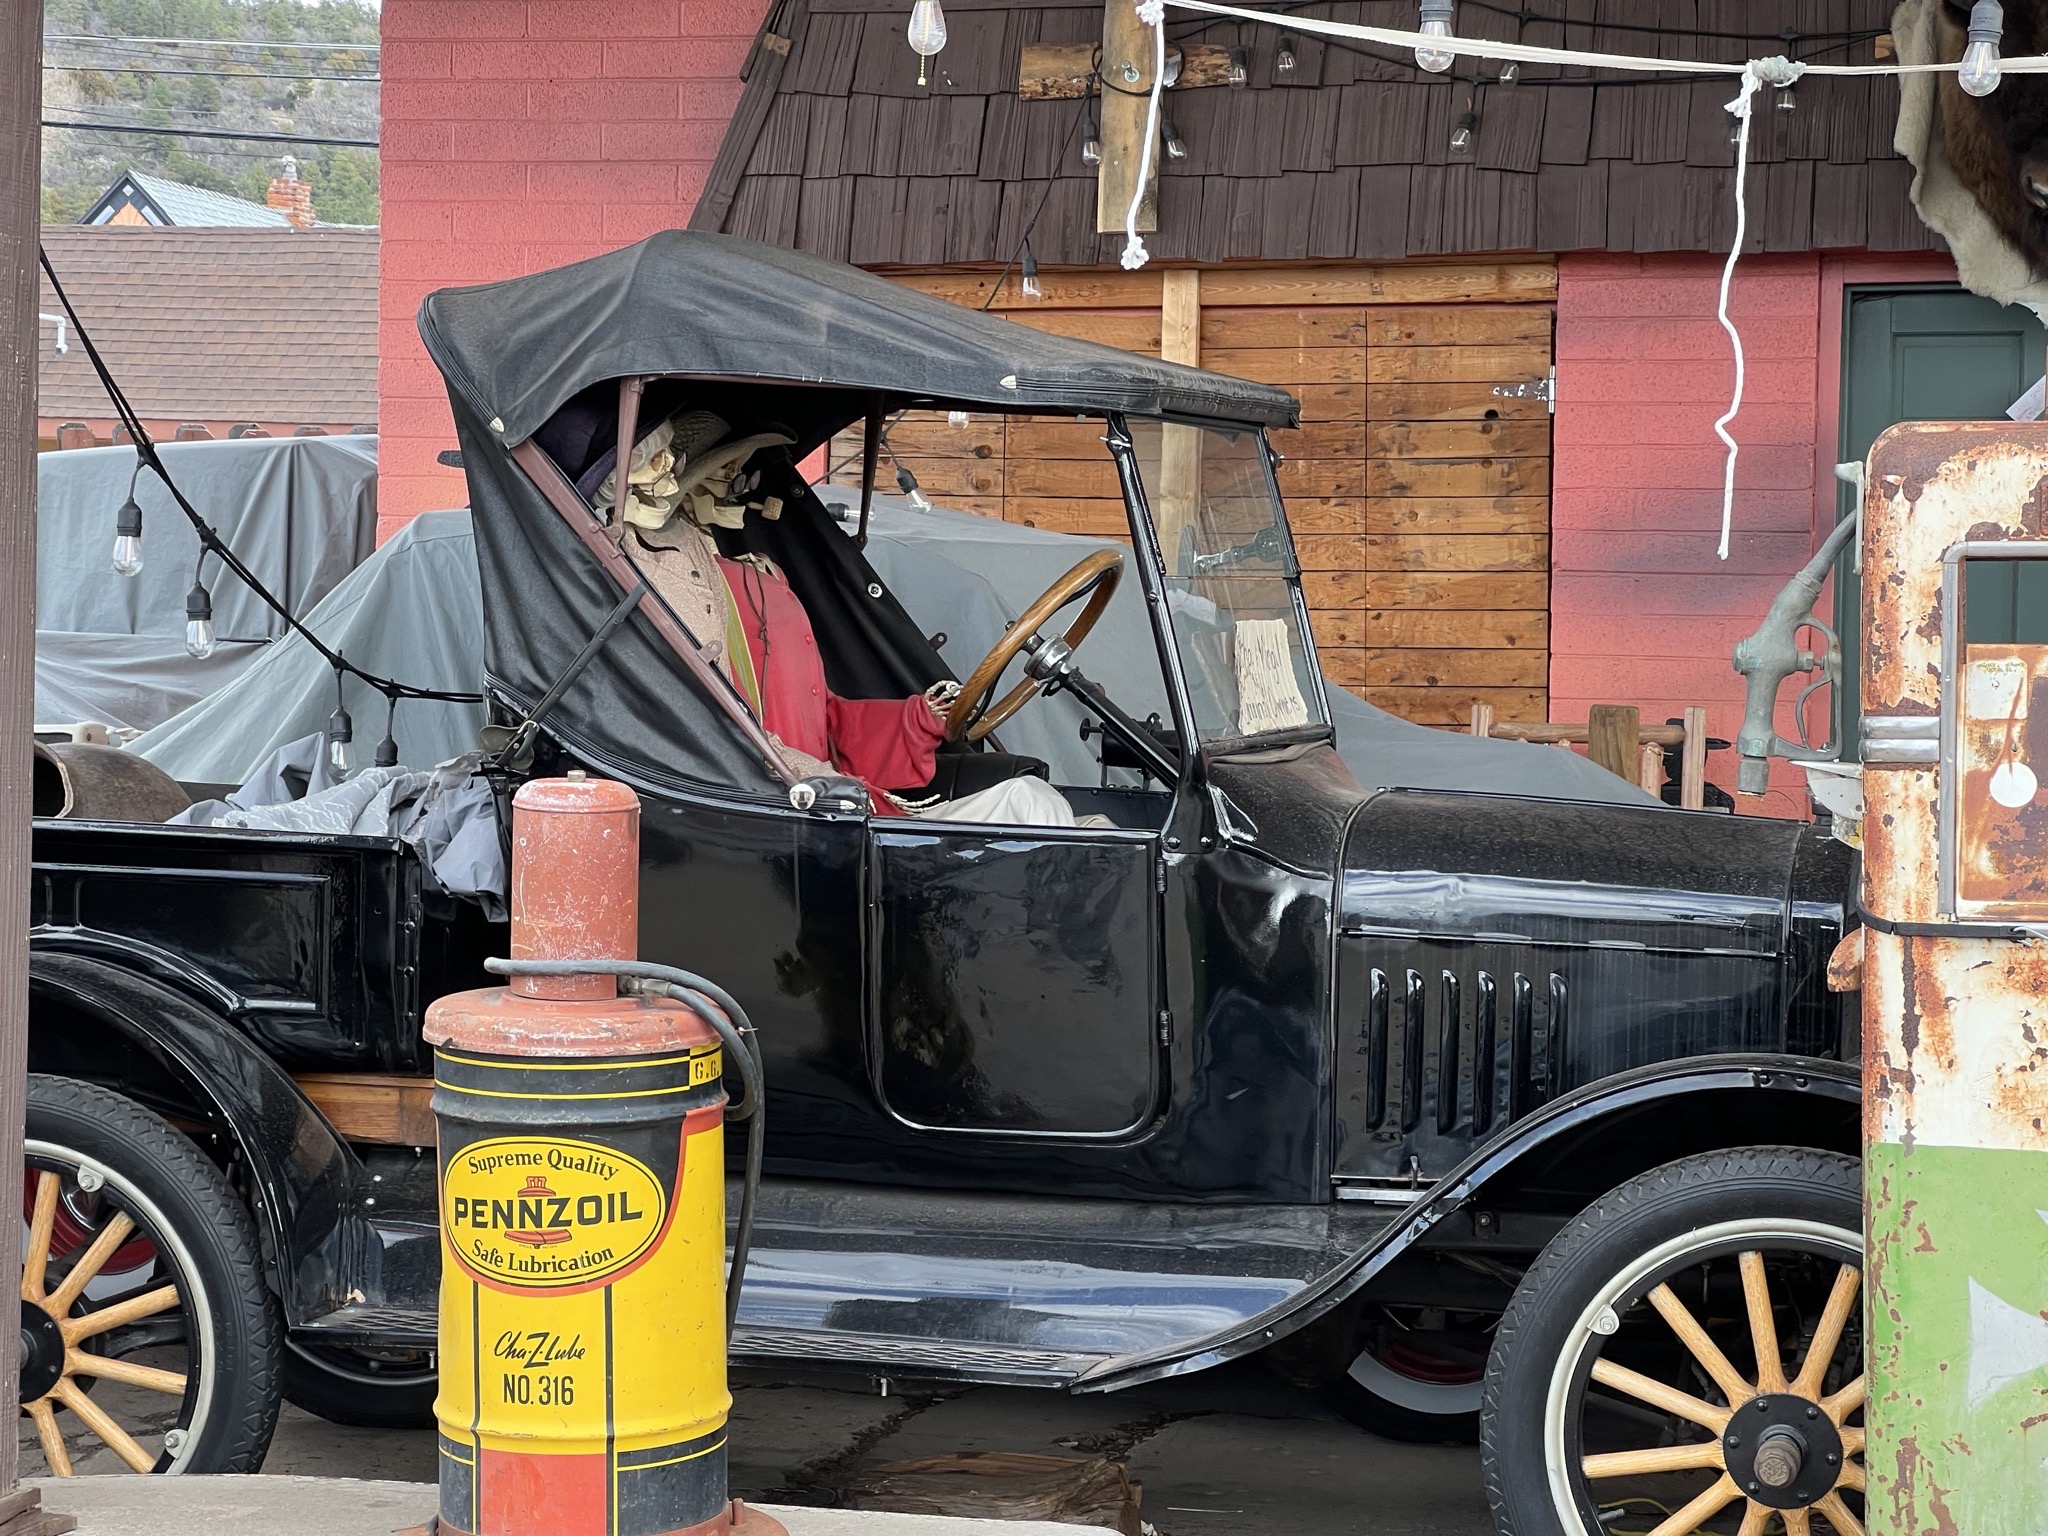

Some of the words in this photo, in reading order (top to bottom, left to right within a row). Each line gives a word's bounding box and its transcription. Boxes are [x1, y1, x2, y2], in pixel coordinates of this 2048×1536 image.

[468, 1153, 543, 1175] Supreme
[547, 1149, 620, 1181] Quality
[454, 1191, 643, 1229] PENNZOIL
[472, 1238, 504, 1268] Safe
[508, 1247, 614, 1273] Lubrication
[503, 1373, 534, 1404] NO.
[538, 1375, 574, 1406] 316
